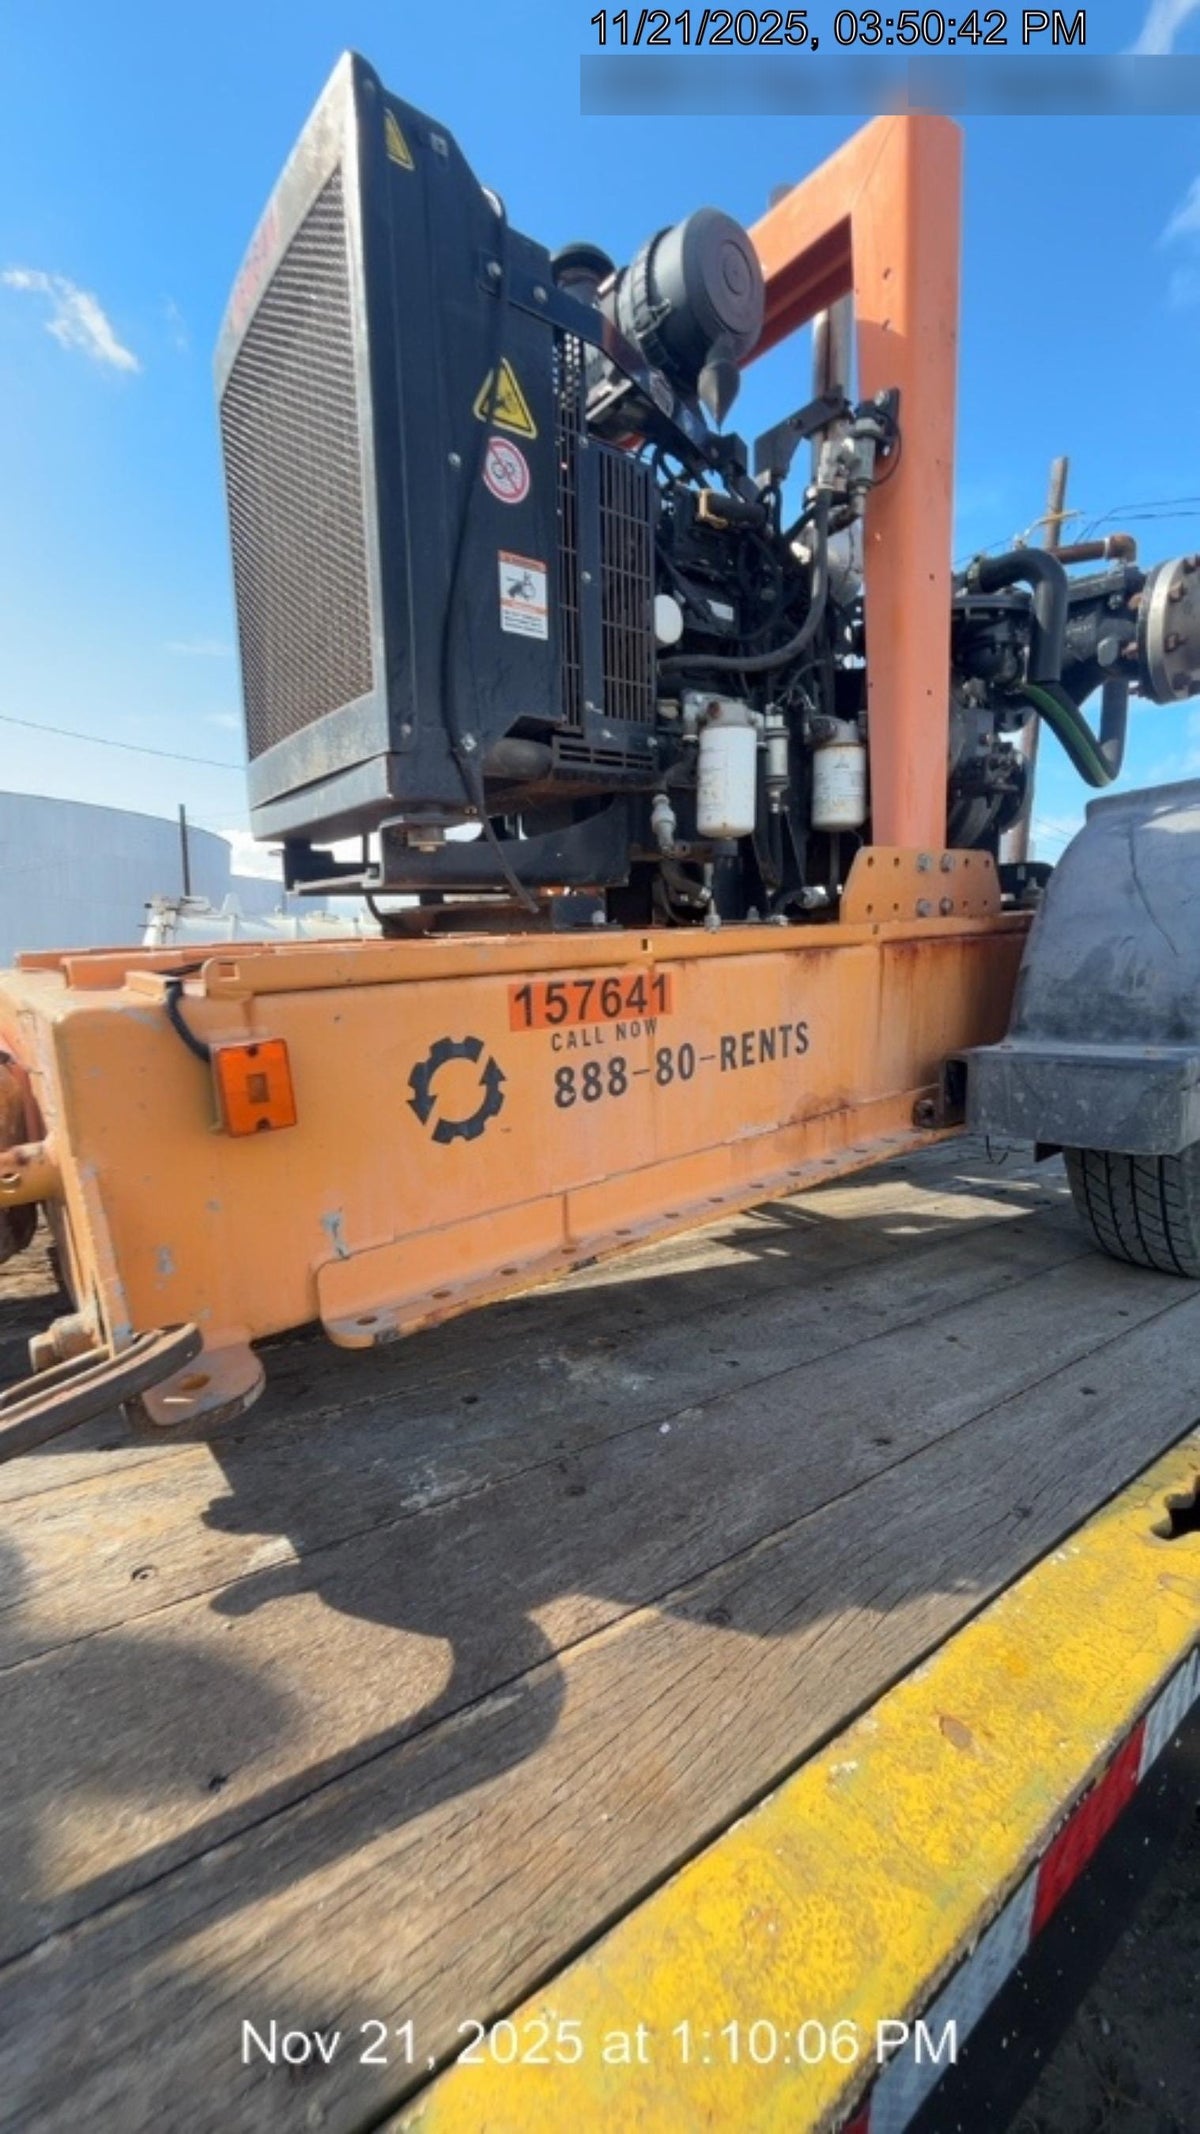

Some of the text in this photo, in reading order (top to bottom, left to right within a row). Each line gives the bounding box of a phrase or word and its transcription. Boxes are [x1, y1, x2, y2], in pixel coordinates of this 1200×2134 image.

[515, 974, 668, 1027] 157641
[551, 1018, 658, 1052] CALL NOW
[555, 1022, 809, 1109] 888-80-RENTS
